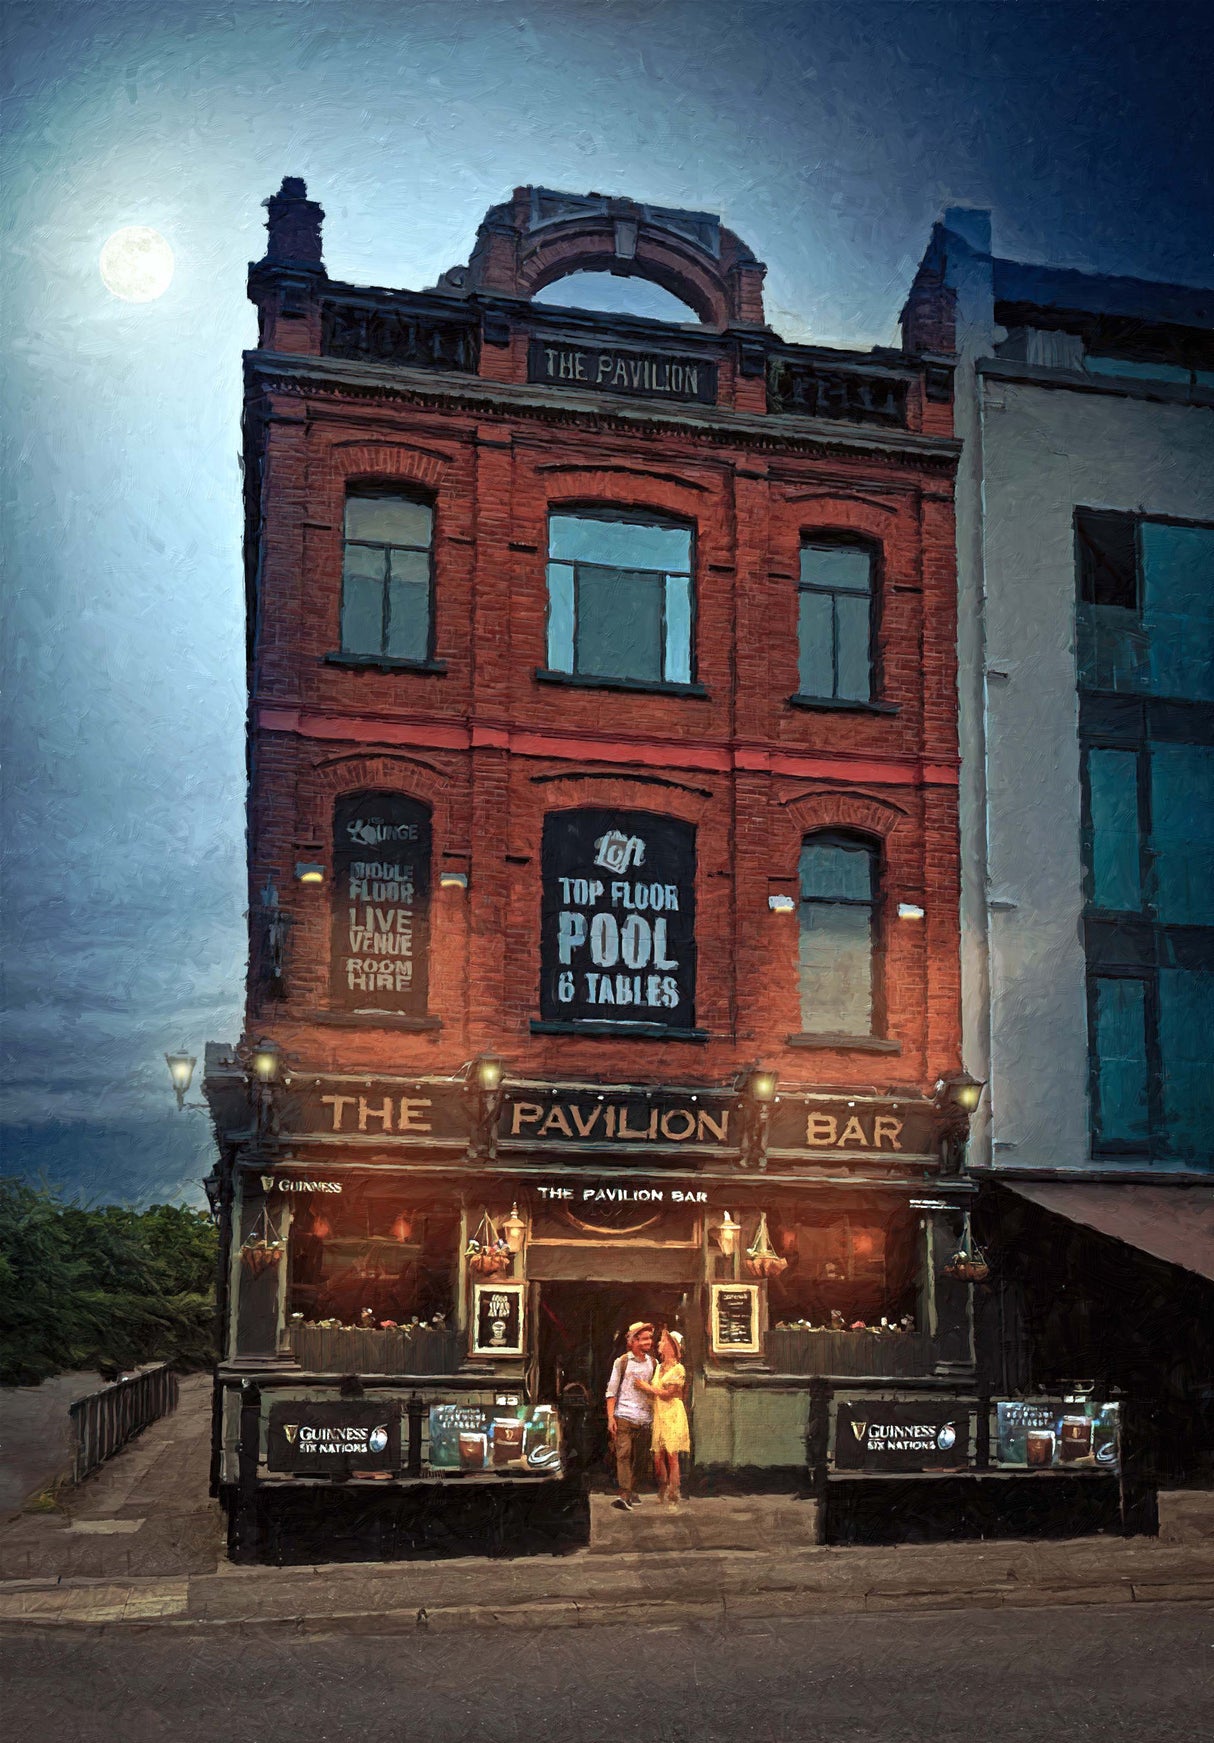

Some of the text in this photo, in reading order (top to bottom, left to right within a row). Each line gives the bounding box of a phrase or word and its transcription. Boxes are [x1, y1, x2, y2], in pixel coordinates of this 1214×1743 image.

[545, 349, 698, 394] THE PAVILION
[558, 877, 679, 911] TOP FLOOR
[349, 906, 413, 934] LIVE
[350, 931, 413, 956] VENUE
[557, 911, 679, 970] POOL
[346, 958, 413, 976] ROOM
[348, 973, 412, 992] HIRE
[558, 971, 680, 1009] 6 TABLES
[321, 1095, 903, 1149] THE PAVILION BAR
[278, 1179, 343, 1194] GUINNESS
[537, 1187, 708, 1203] THE PAVILION BAR
[299, 1427, 369, 1441] GUINNESS
[867, 1424, 937, 1439] GUINNESS
[300, 1443, 367, 1454] SIX NATIONS
[867, 1441, 936, 1450] SIX NATIONS
